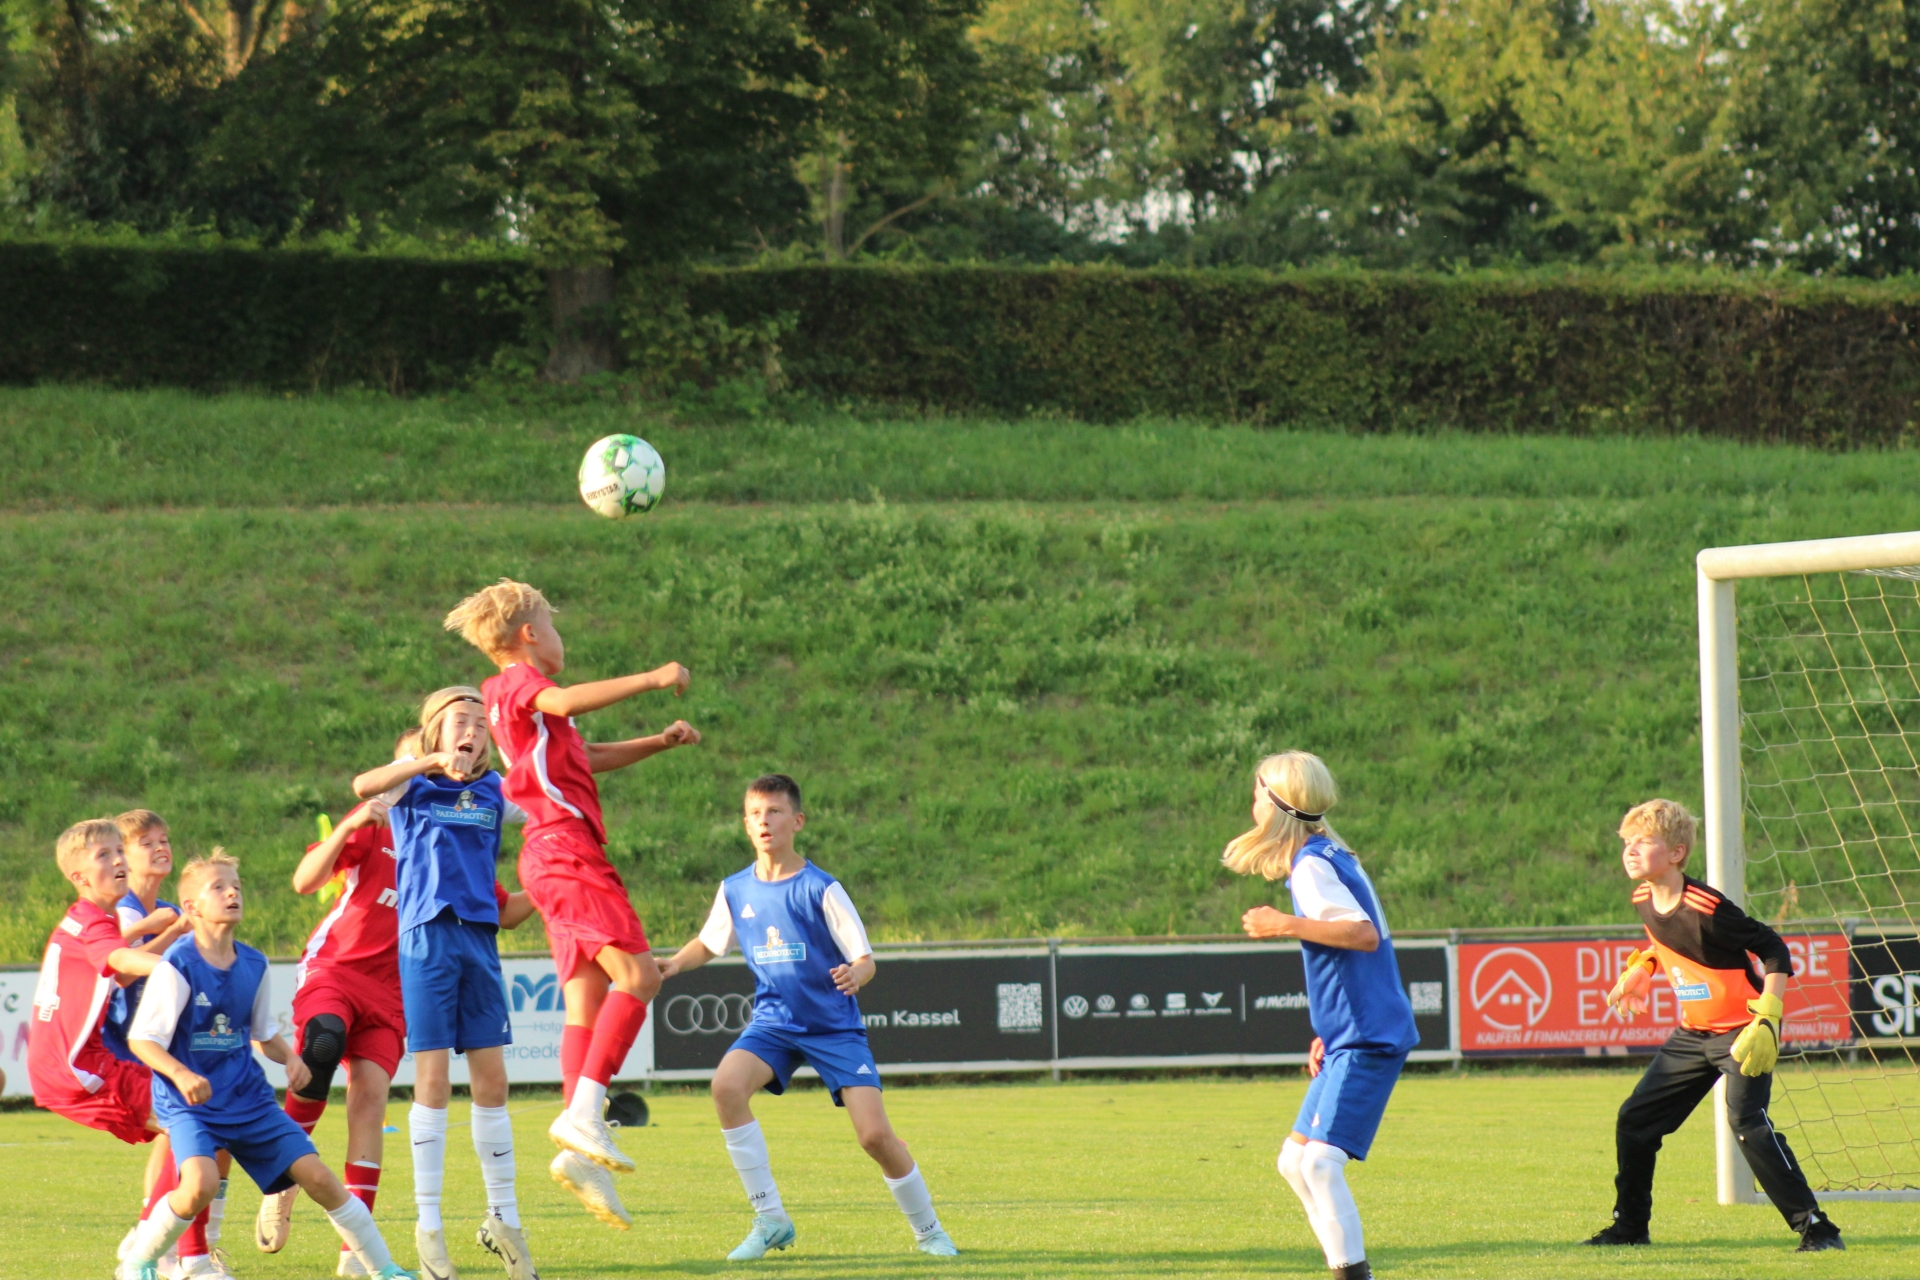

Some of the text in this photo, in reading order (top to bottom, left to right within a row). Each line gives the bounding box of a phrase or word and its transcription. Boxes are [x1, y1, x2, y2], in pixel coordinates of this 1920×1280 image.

[892, 1008, 961, 1027] Kassel
[1476, 1031, 1522, 1044] KAUFEN
[1533, 1028, 1609, 1043] FINANZIEREN
[1780, 1021, 1840, 1036] ERWALTEN
[502, 1041, 561, 1060] ercede
